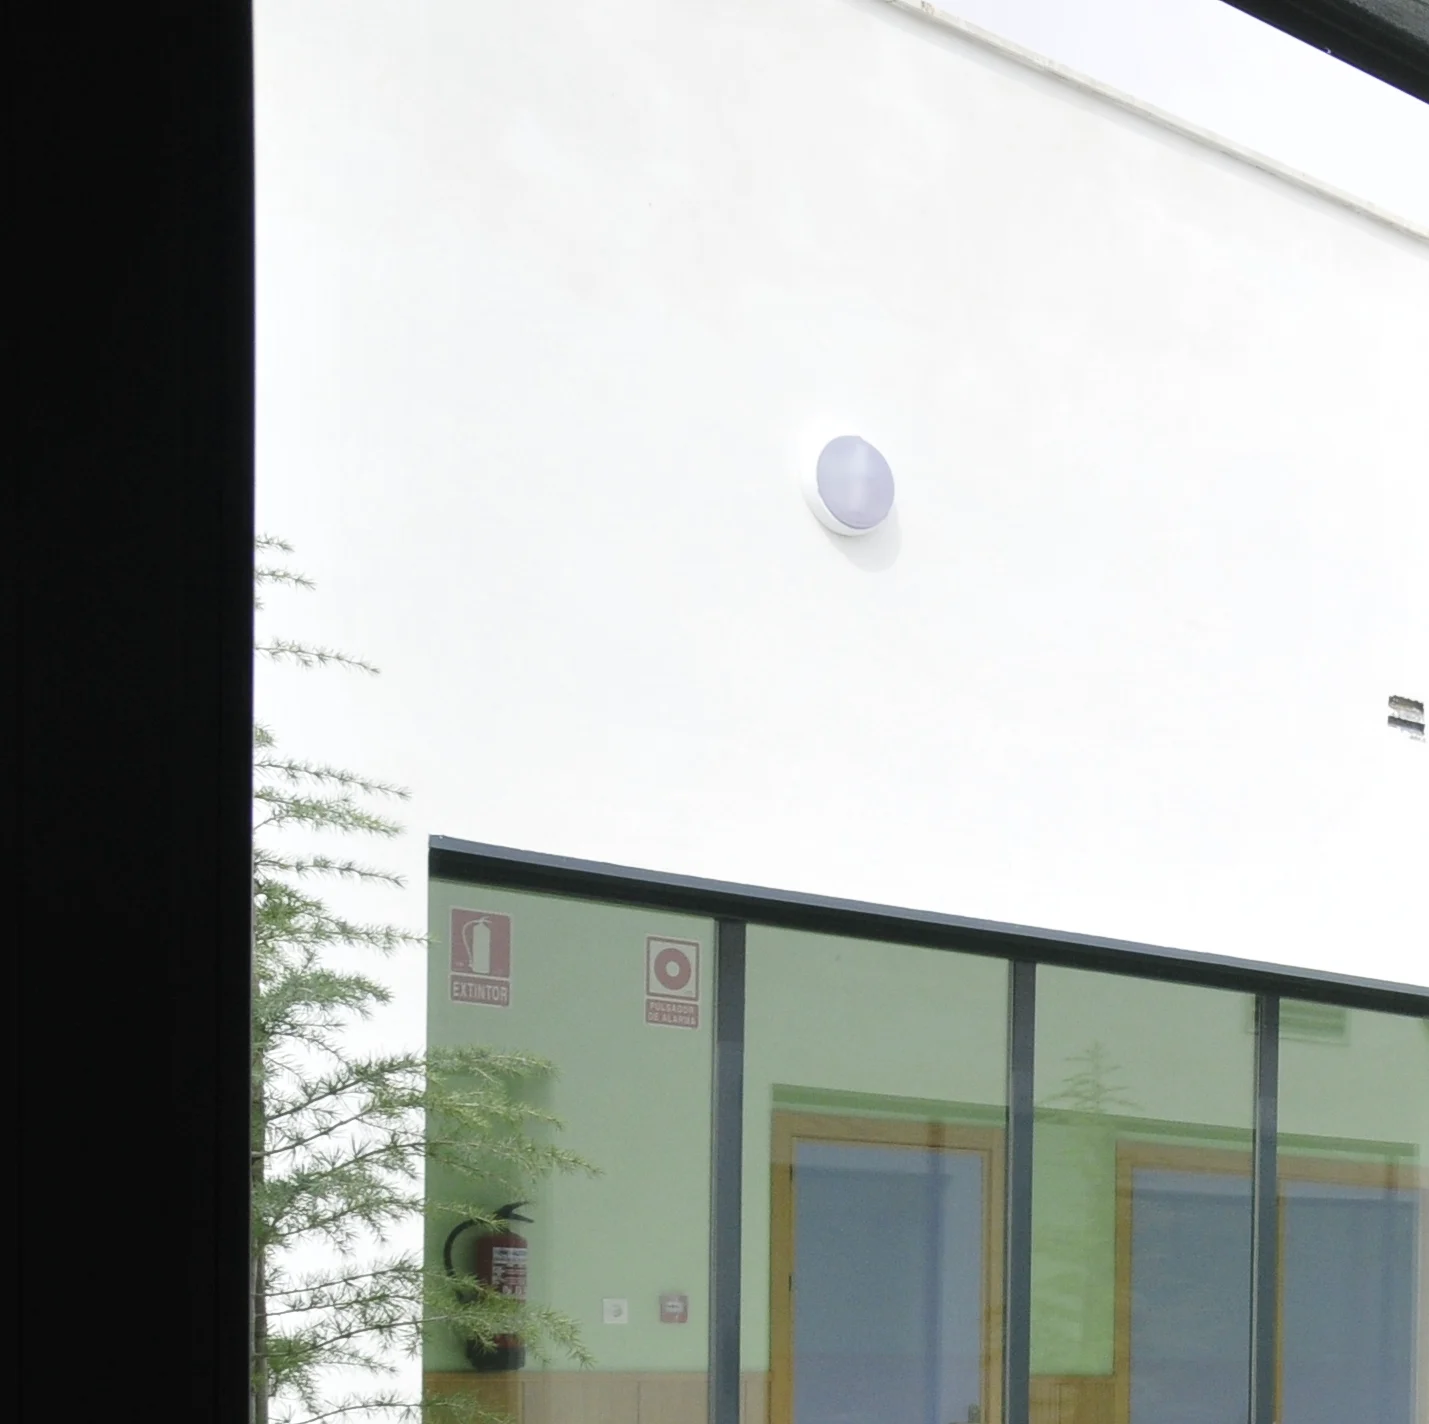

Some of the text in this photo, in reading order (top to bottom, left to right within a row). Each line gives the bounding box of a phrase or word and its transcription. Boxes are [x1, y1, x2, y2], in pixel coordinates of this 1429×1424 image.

[453, 981, 508, 1003] EXTINTOR
[649, 1001, 695, 1014] PULSADOR
[647, 1011, 697, 1026] DE ALARMA
